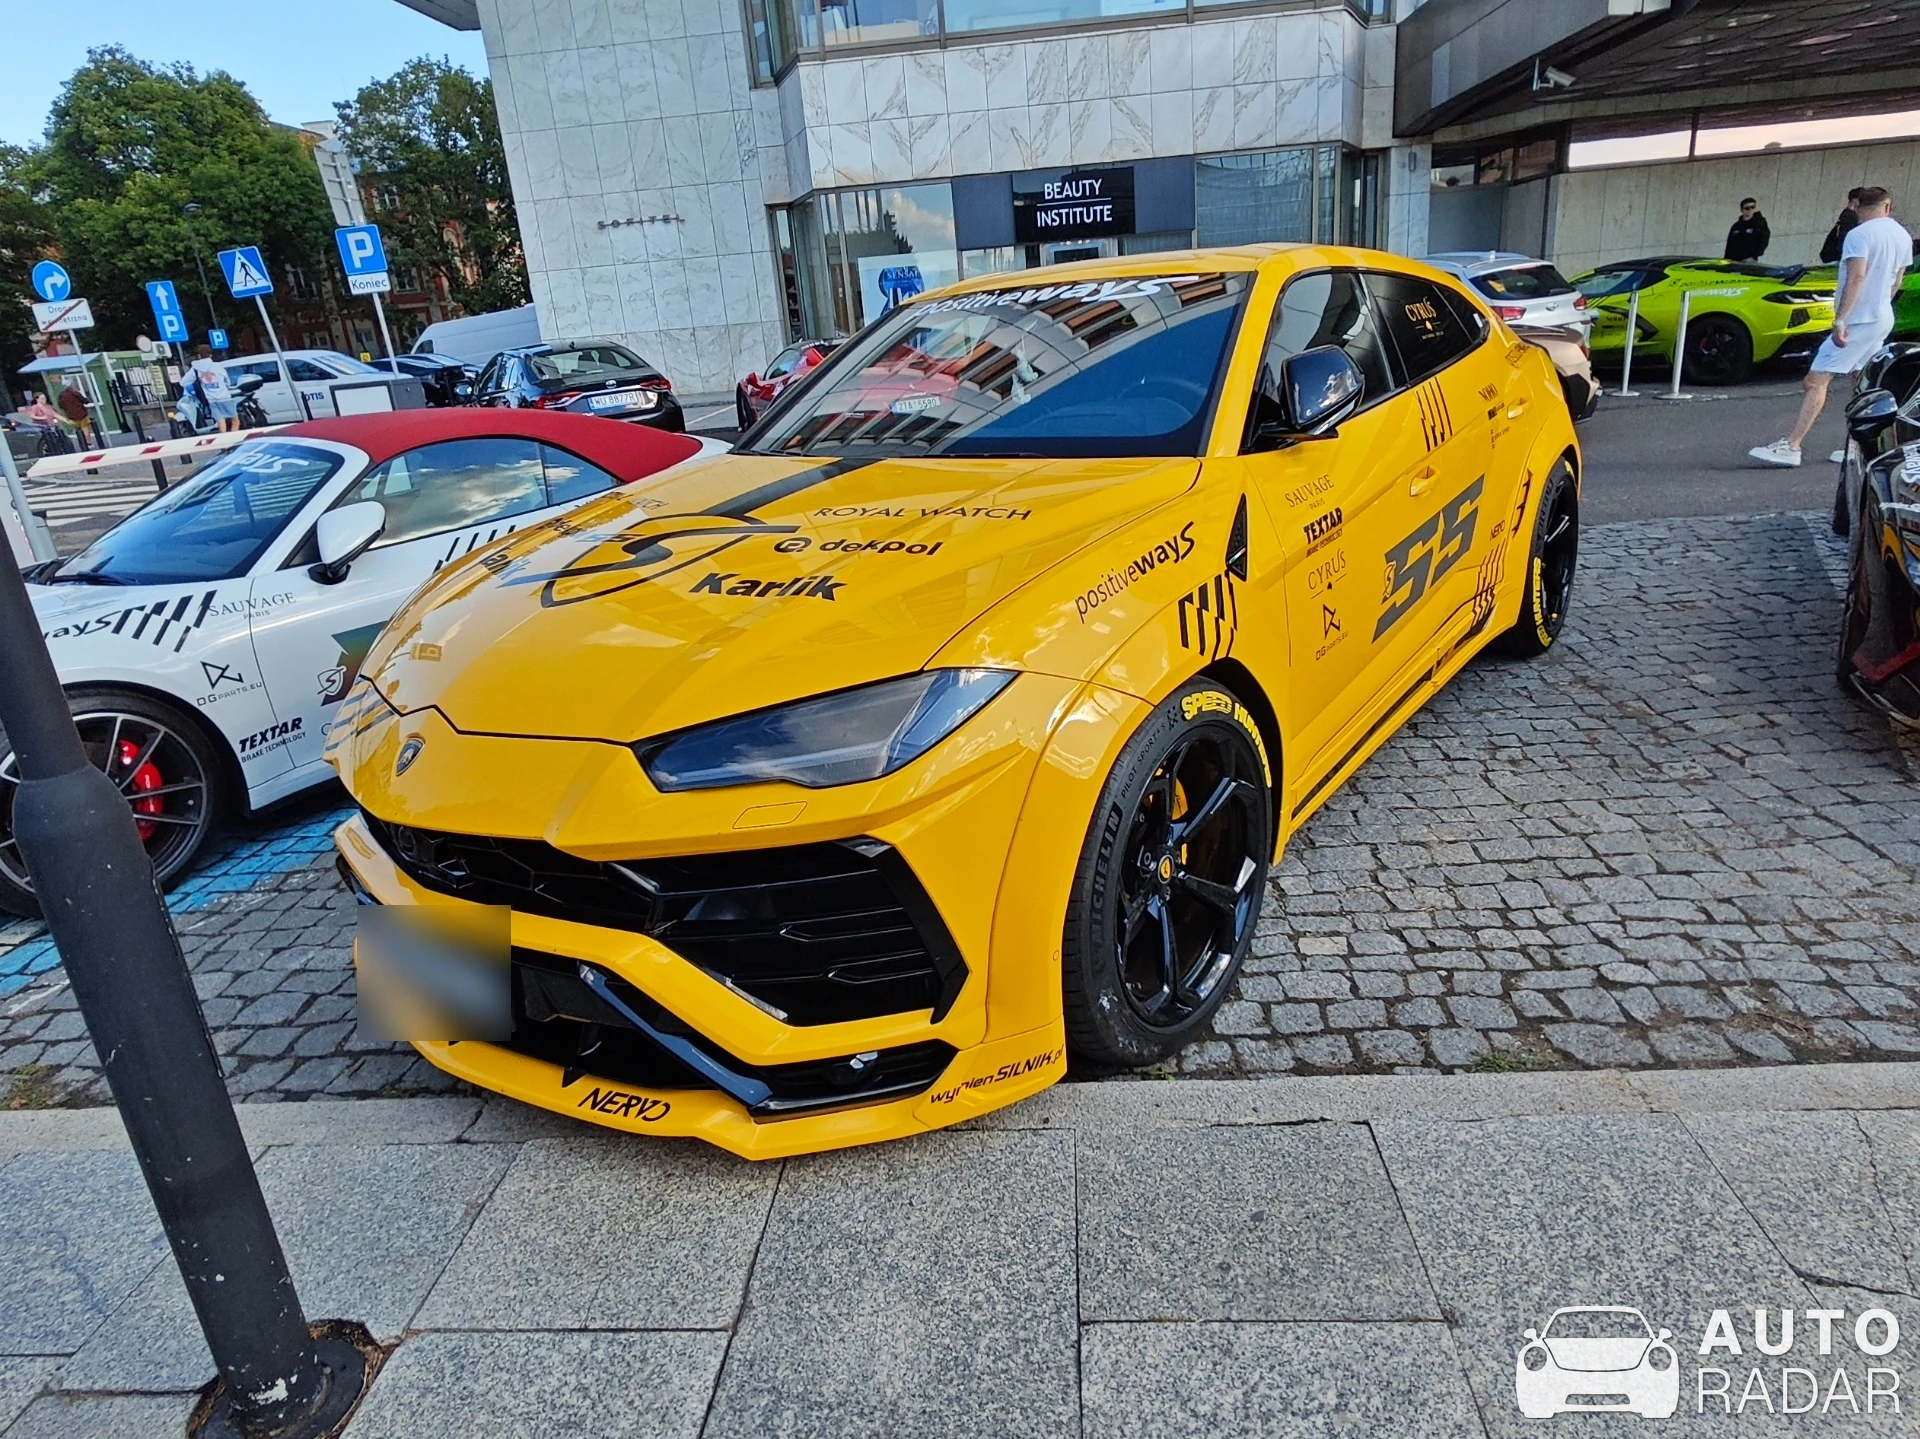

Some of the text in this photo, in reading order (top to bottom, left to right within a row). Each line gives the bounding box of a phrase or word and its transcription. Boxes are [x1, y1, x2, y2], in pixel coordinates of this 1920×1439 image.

[1043, 178, 1102, 200] BEAUTY
[597, 213, 685, 230] SOFITEL
[1036, 204, 1112, 228] INSTITUTE
[345, 231, 375, 269] P
[351, 276, 388, 291] Koniec
[162, 315, 181, 338] P
[212, 331, 224, 346] P
[1284, 473, 1335, 508] SAUVAGE
[812, 506, 1033, 521] ROYAL WATCH
[1302, 506, 1343, 546] TEXTAR
[818, 538, 945, 556] dekpol
[1371, 472, 1486, 645] 55
[1075, 520, 1196, 624] positiveways
[1307, 548, 1347, 590] CYRUS
[688, 572, 849, 602] Karlik
[208, 591, 297, 618] SAUVAGE
[243, 609, 271, 620] PARIS
[1181, 690, 1233, 720] SPEED
[238, 716, 303, 754] TEXTAR
[241, 731, 307, 763] BRAKE TECHNOLOGY
[1120, 768, 1138, 799] PILOT
[1136, 732, 1158, 765] SPORT
[576, 1087, 671, 1122] NERVO
